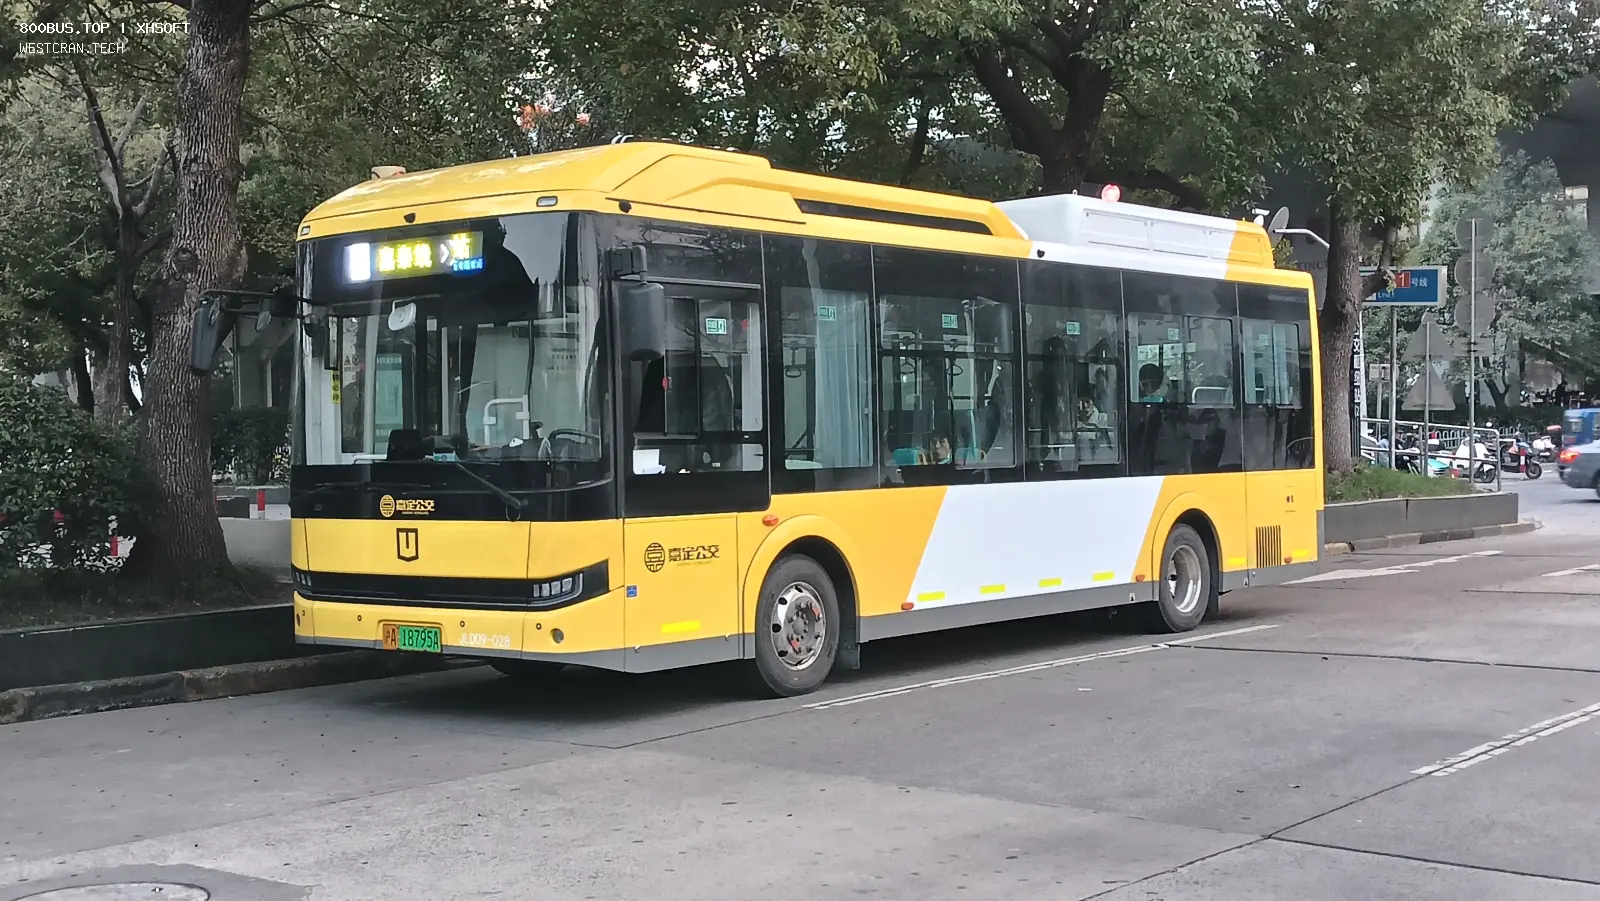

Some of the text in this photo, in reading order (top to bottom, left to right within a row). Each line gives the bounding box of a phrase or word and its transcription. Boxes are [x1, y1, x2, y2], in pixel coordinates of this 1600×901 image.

[667, 544, 721, 563] 嘉定公交
[459, 632, 511, 648] JLD09-028
